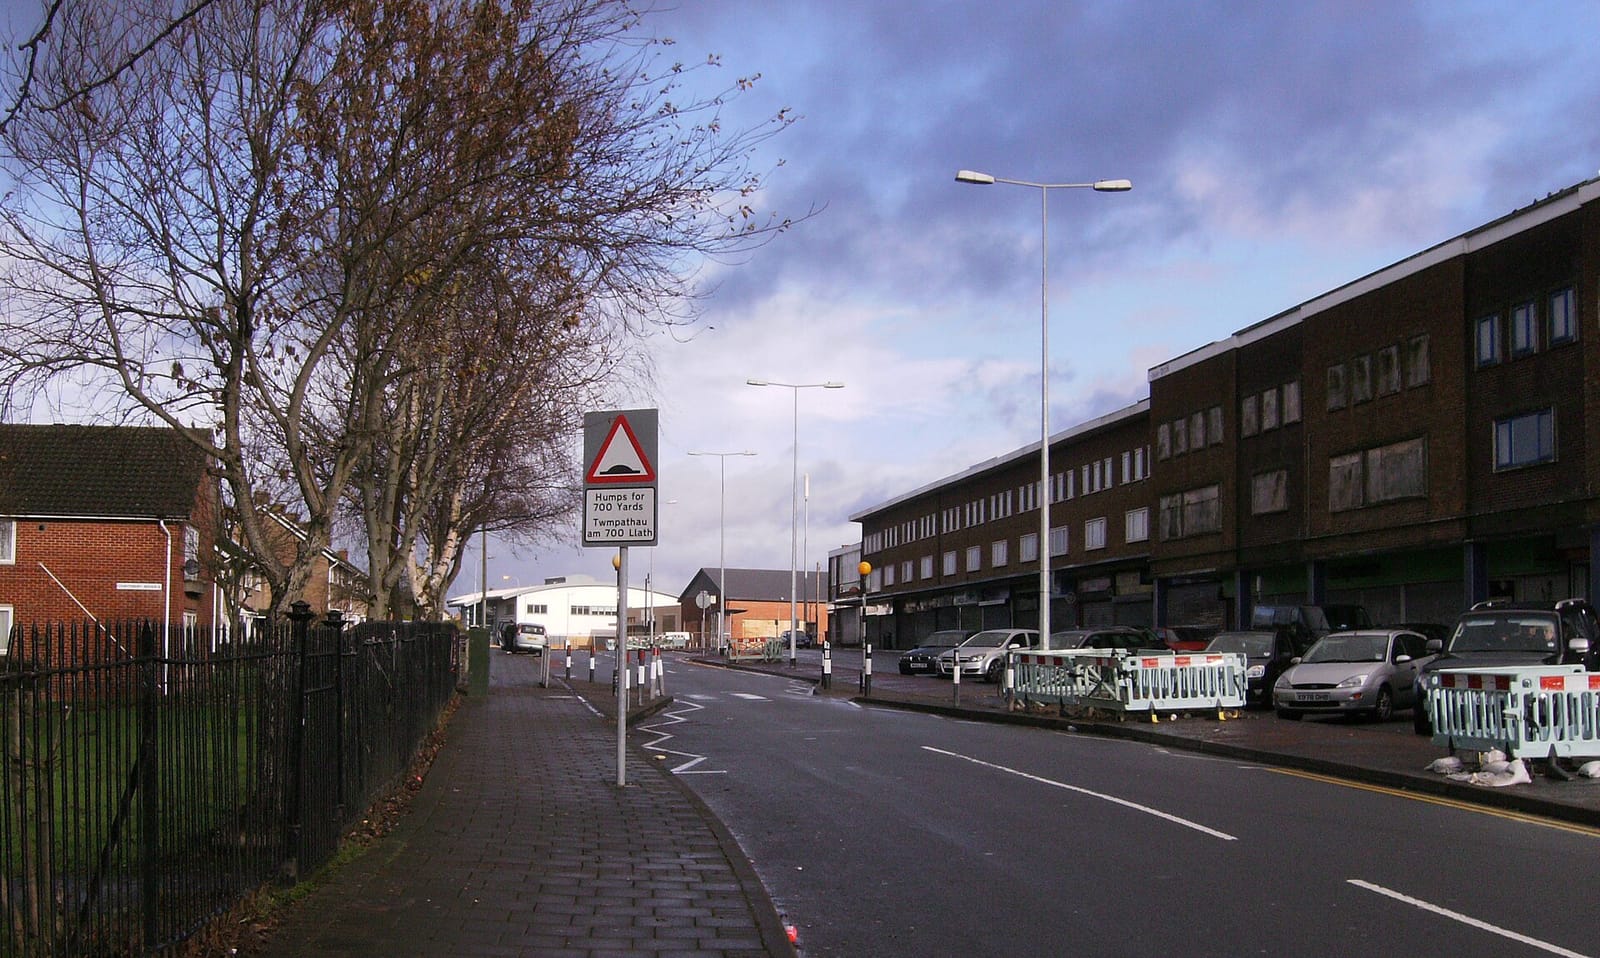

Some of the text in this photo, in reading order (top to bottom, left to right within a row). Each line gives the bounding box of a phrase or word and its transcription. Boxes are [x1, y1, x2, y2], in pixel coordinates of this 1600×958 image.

[595, 492, 645, 502] Humps for
[593, 502, 643, 511] 700 Yards
[593, 518, 647, 527] Twmpathau
[605, 529, 624, 537] 700
[629, 528, 652, 537] Llath
